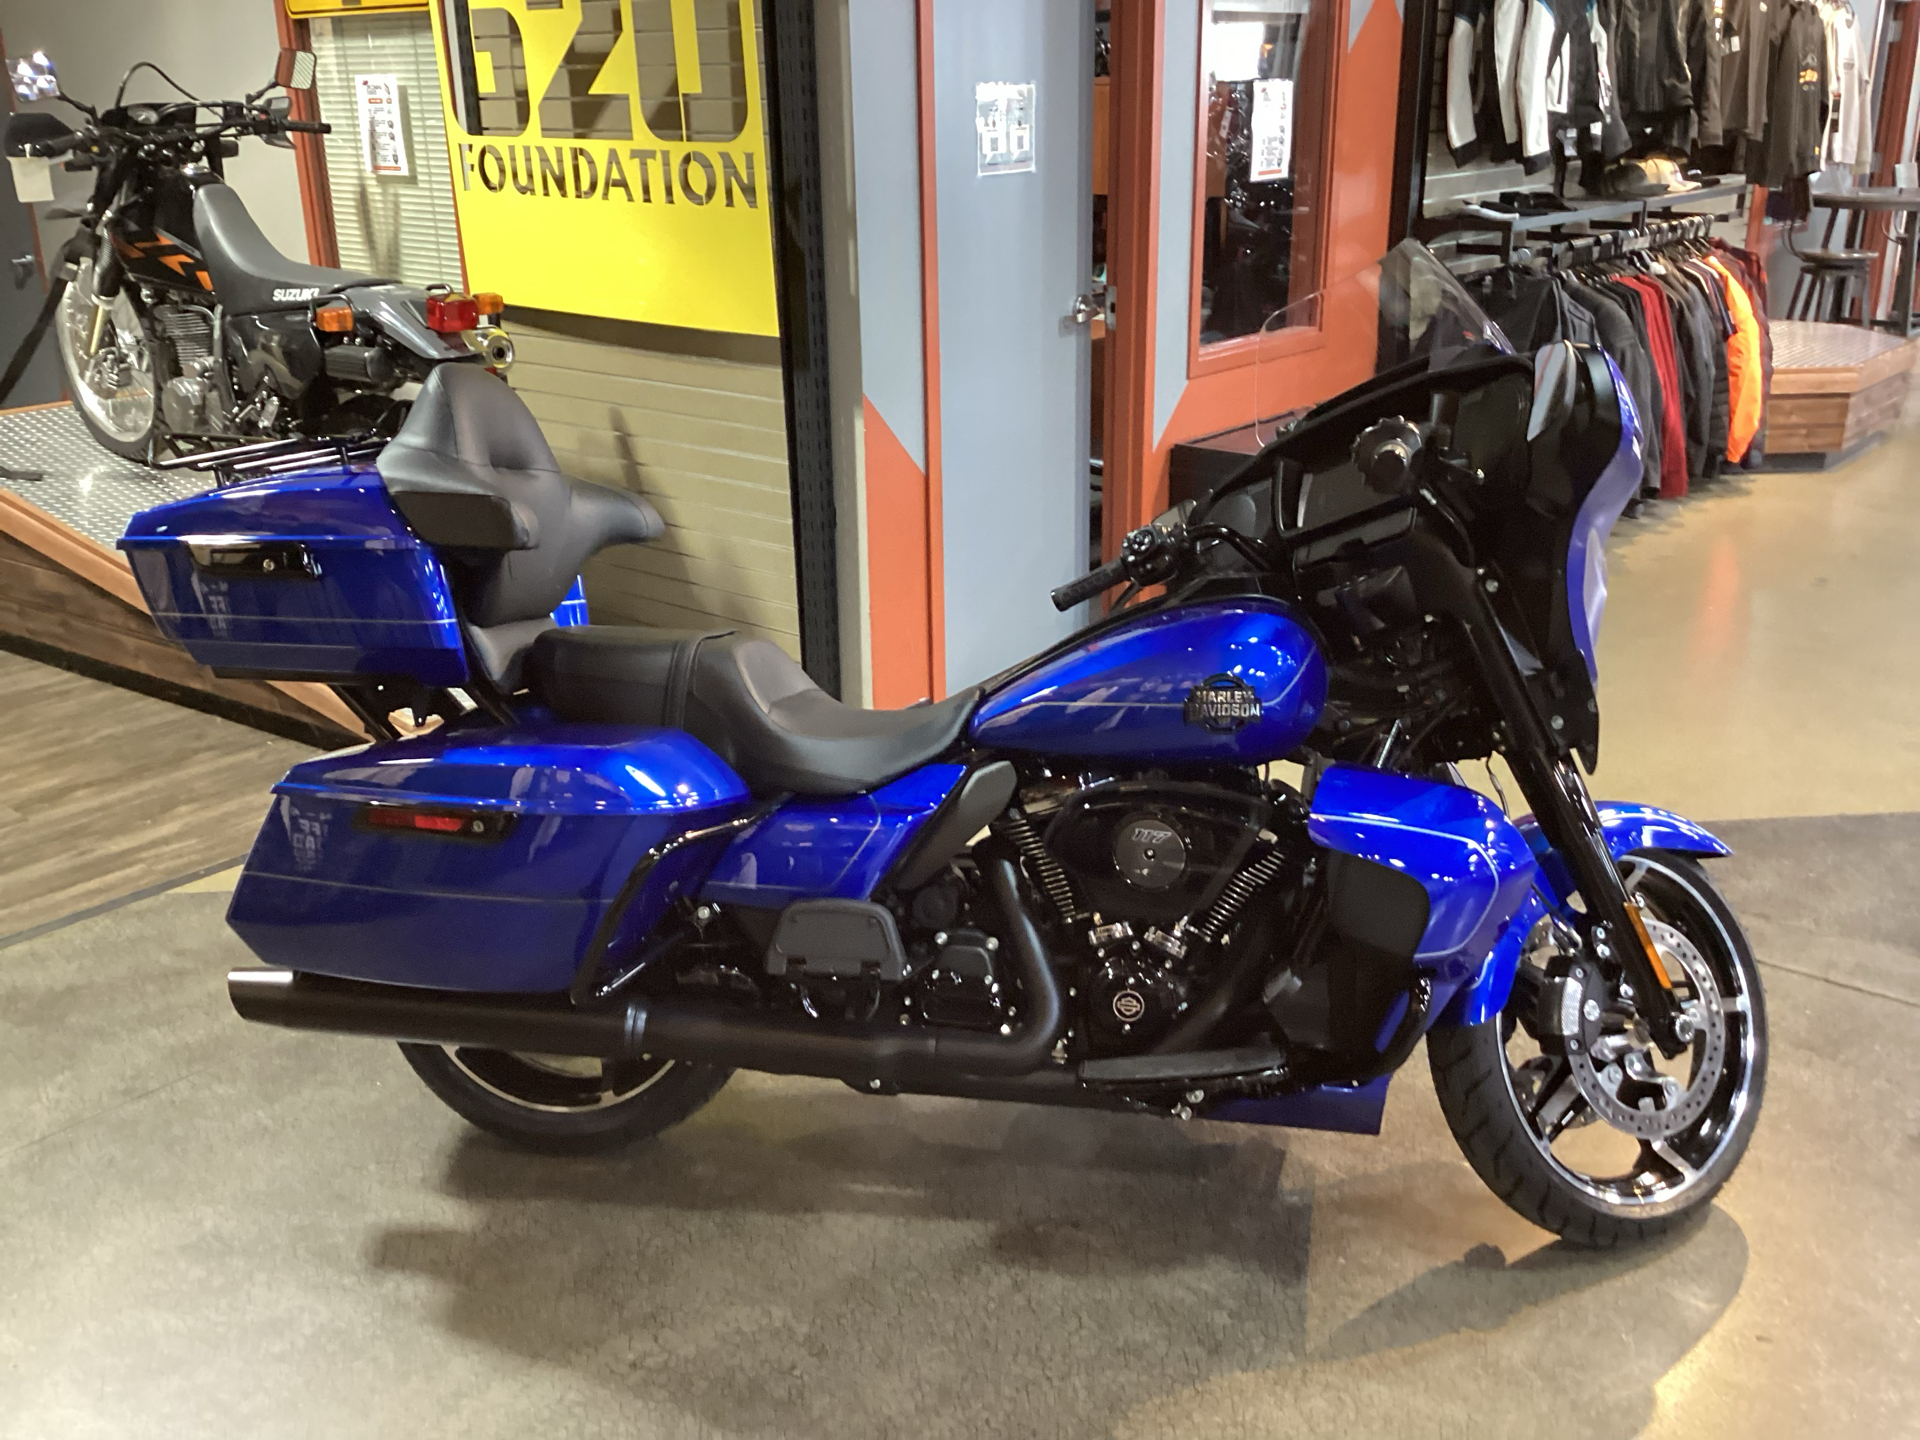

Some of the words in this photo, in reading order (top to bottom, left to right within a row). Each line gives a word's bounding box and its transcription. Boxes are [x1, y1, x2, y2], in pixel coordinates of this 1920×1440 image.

[458, 143, 759, 209] FOUNDATION
[272, 287, 320, 302] SUZUKI
[1132, 827, 1172, 844] 117
